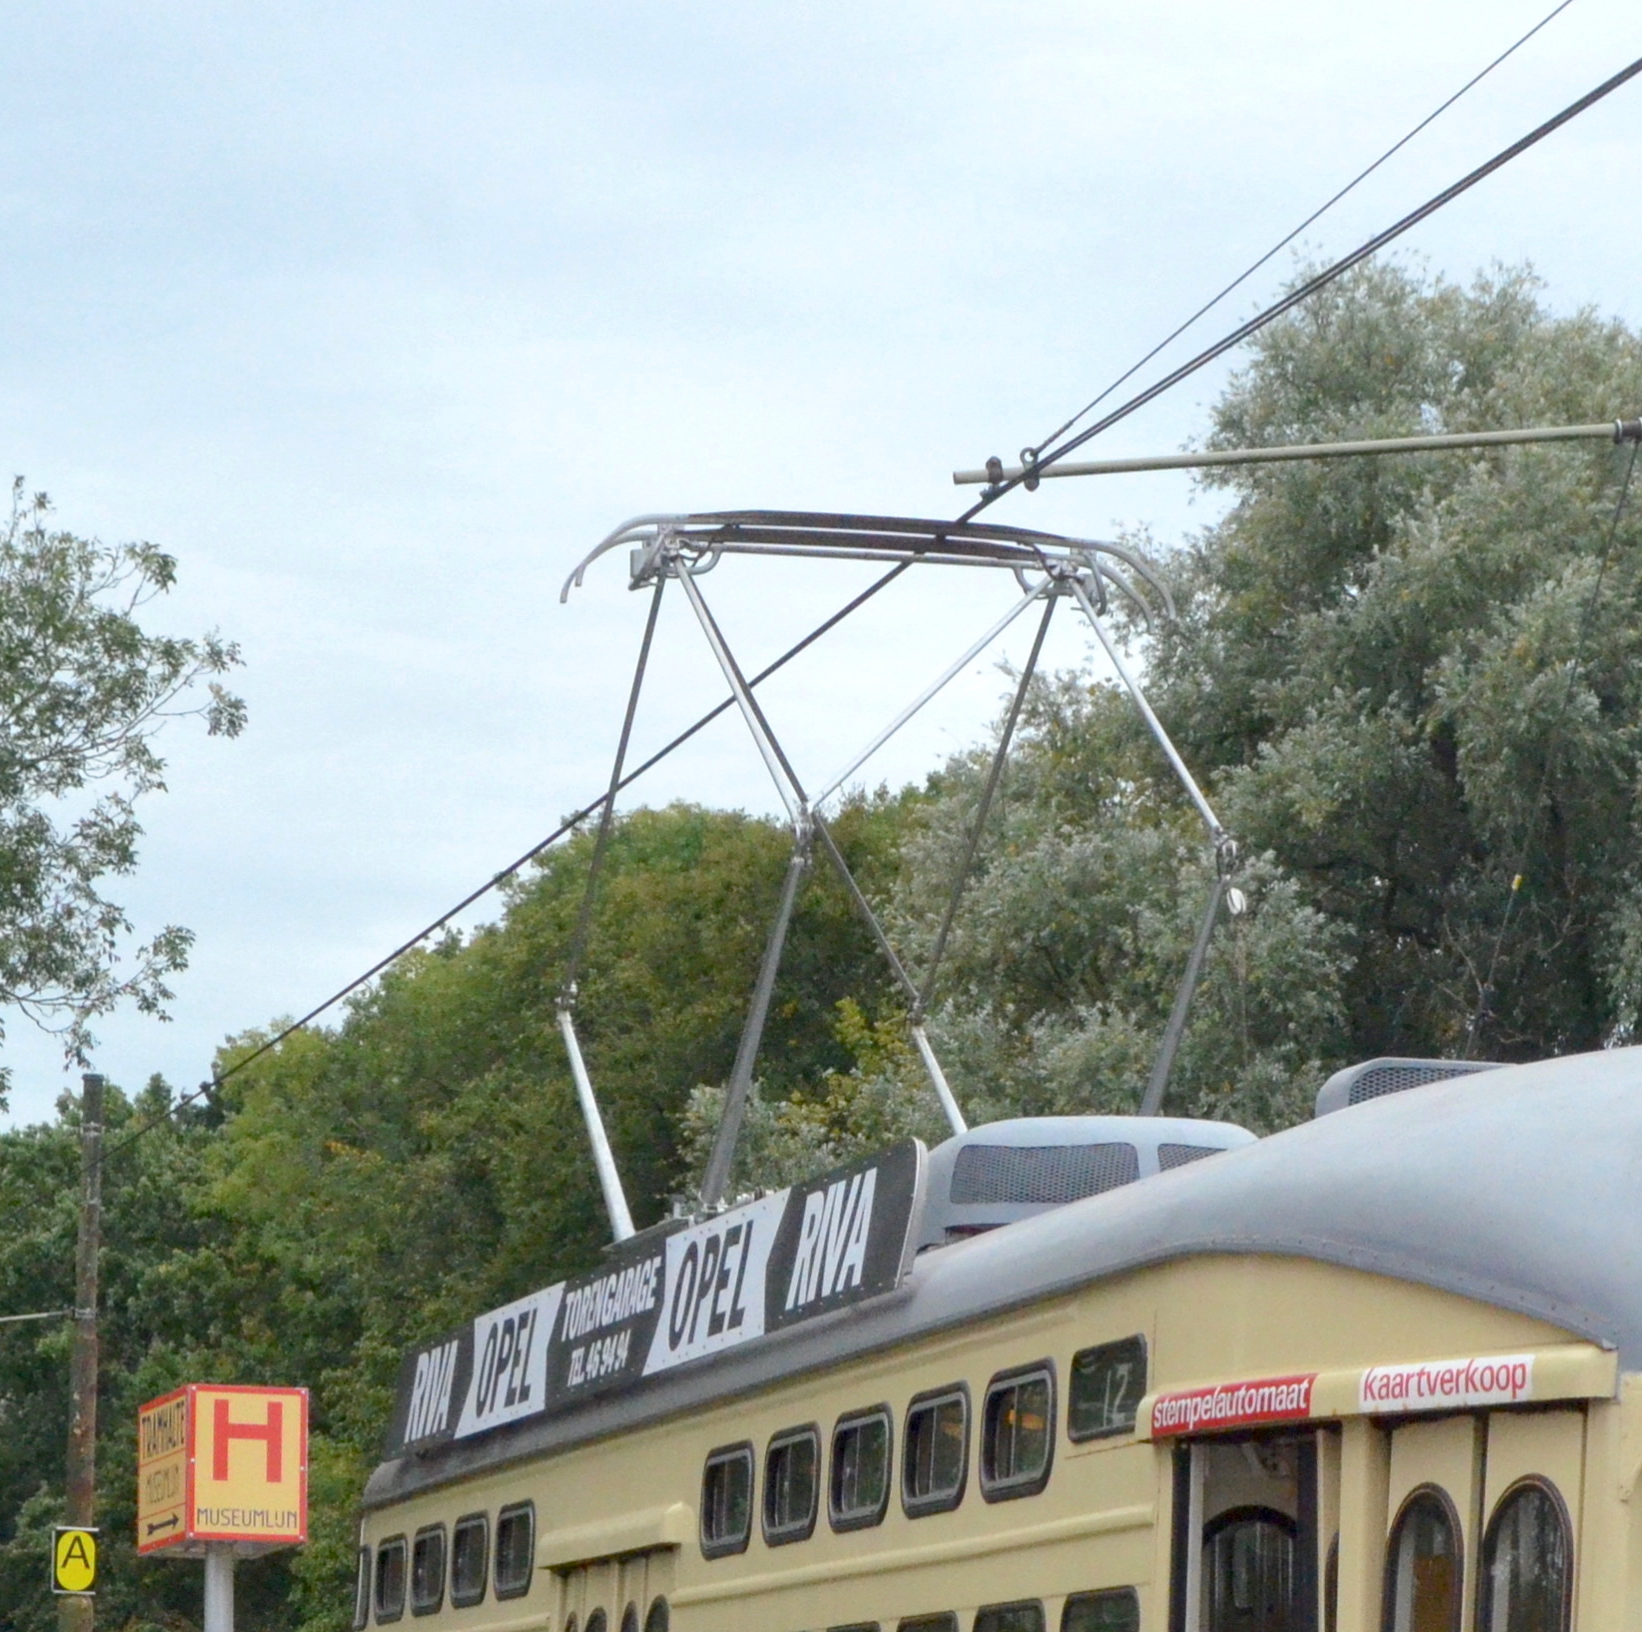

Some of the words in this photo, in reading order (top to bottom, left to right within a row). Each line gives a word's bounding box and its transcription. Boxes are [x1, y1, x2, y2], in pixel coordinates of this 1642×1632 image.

[785, 1168, 878, 1310] RIVA
[561, 1256, 662, 1342] TORENGARAGE
[668, 1219, 754, 1352] OPEL
[404, 1340, 458, 1443] RIVA
[475, 1308, 538, 1419] OPEL
[1153, 1377, 1309, 1430] stempelautomaat
[1364, 1359, 1526, 1402] kaartverkoop
[212, 1399, 283, 1483] H
[61, 1535, 90, 1569] A
